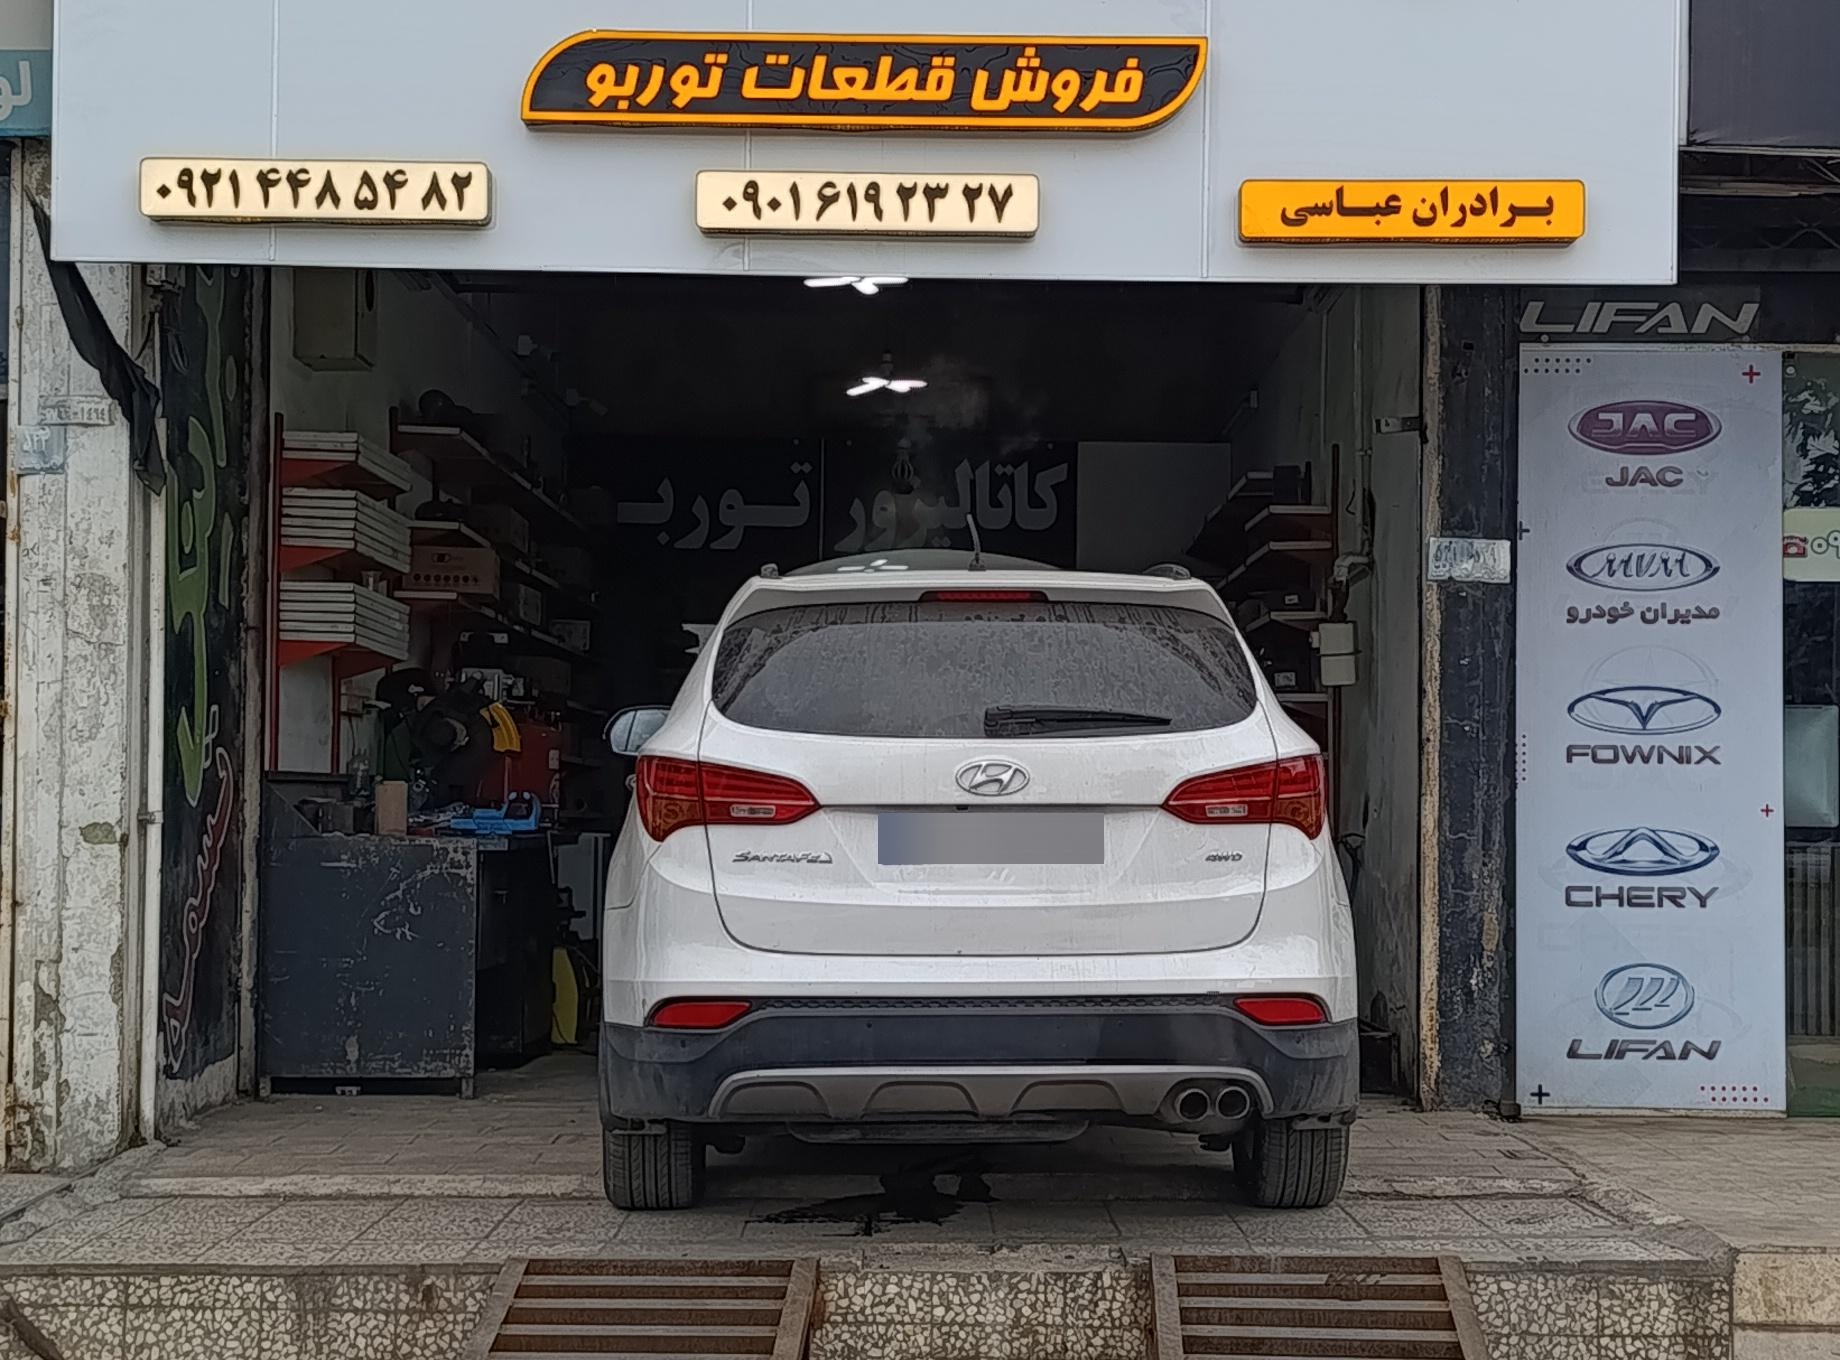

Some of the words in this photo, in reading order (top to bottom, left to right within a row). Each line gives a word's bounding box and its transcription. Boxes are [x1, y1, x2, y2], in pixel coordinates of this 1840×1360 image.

[586, 52, 728, 110] توربو
[741, 54, 956, 102] قطعات
[970, 46, 1144, 113] فروش
[156, 167, 241, 209] ۰۹۲۱
[256, 168, 341, 210] ۴۴۸
[722, 180, 801, 222] ۰۹۰۱
[816, 181, 884, 222] ۶۱۹
[1280, 186, 1402, 227] عباسی
[1412, 185, 1554, 227] برادران
[1519, 301, 1760, 334] LIFAN
[1591, 412, 1696, 438] JAC
[1605, 466, 1684, 488] JAC
[1566, 601, 1634, 624] خودرو
[1640, 602, 1720, 624] مدیران
[1566, 745, 1721, 765] FOWNIX
[1564, 885, 1719, 908] CHERY
[1566, 1039, 1722, 1060] LIFAN
